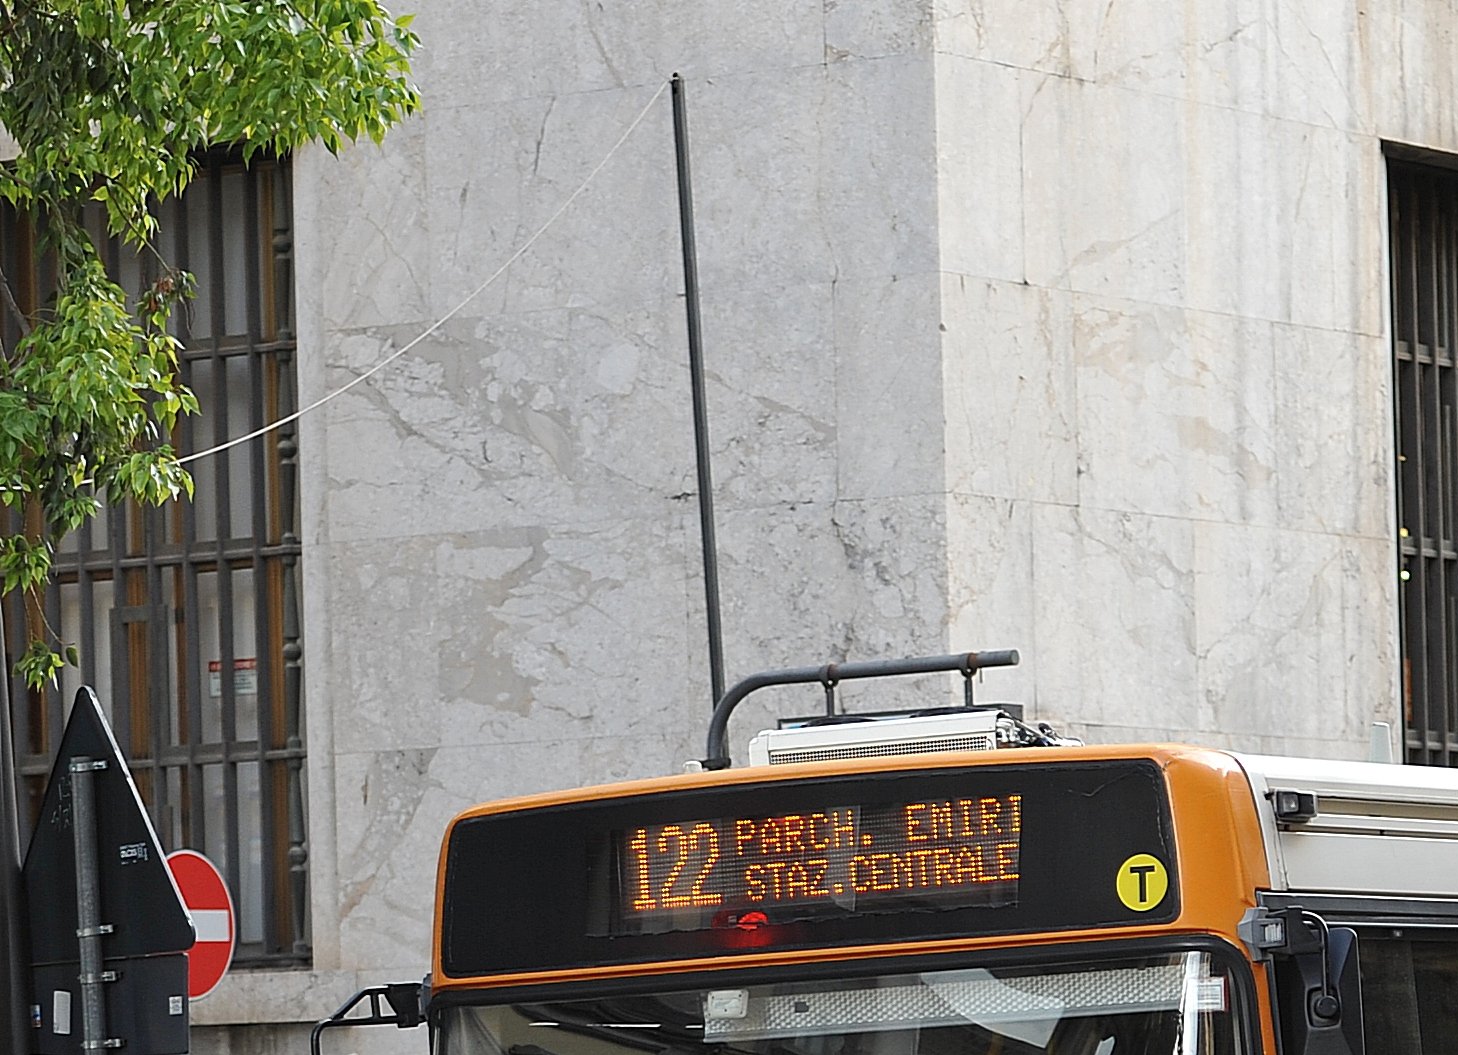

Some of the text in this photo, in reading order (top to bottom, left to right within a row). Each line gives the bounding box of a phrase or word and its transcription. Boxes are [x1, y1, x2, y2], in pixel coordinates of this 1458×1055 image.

[735, 809, 874, 856] PARCH.
[629, 822, 722, 910] 122
[746, 842, 1020, 902] STAZ.CENTRALE
[1130, 864, 1155, 903] T
